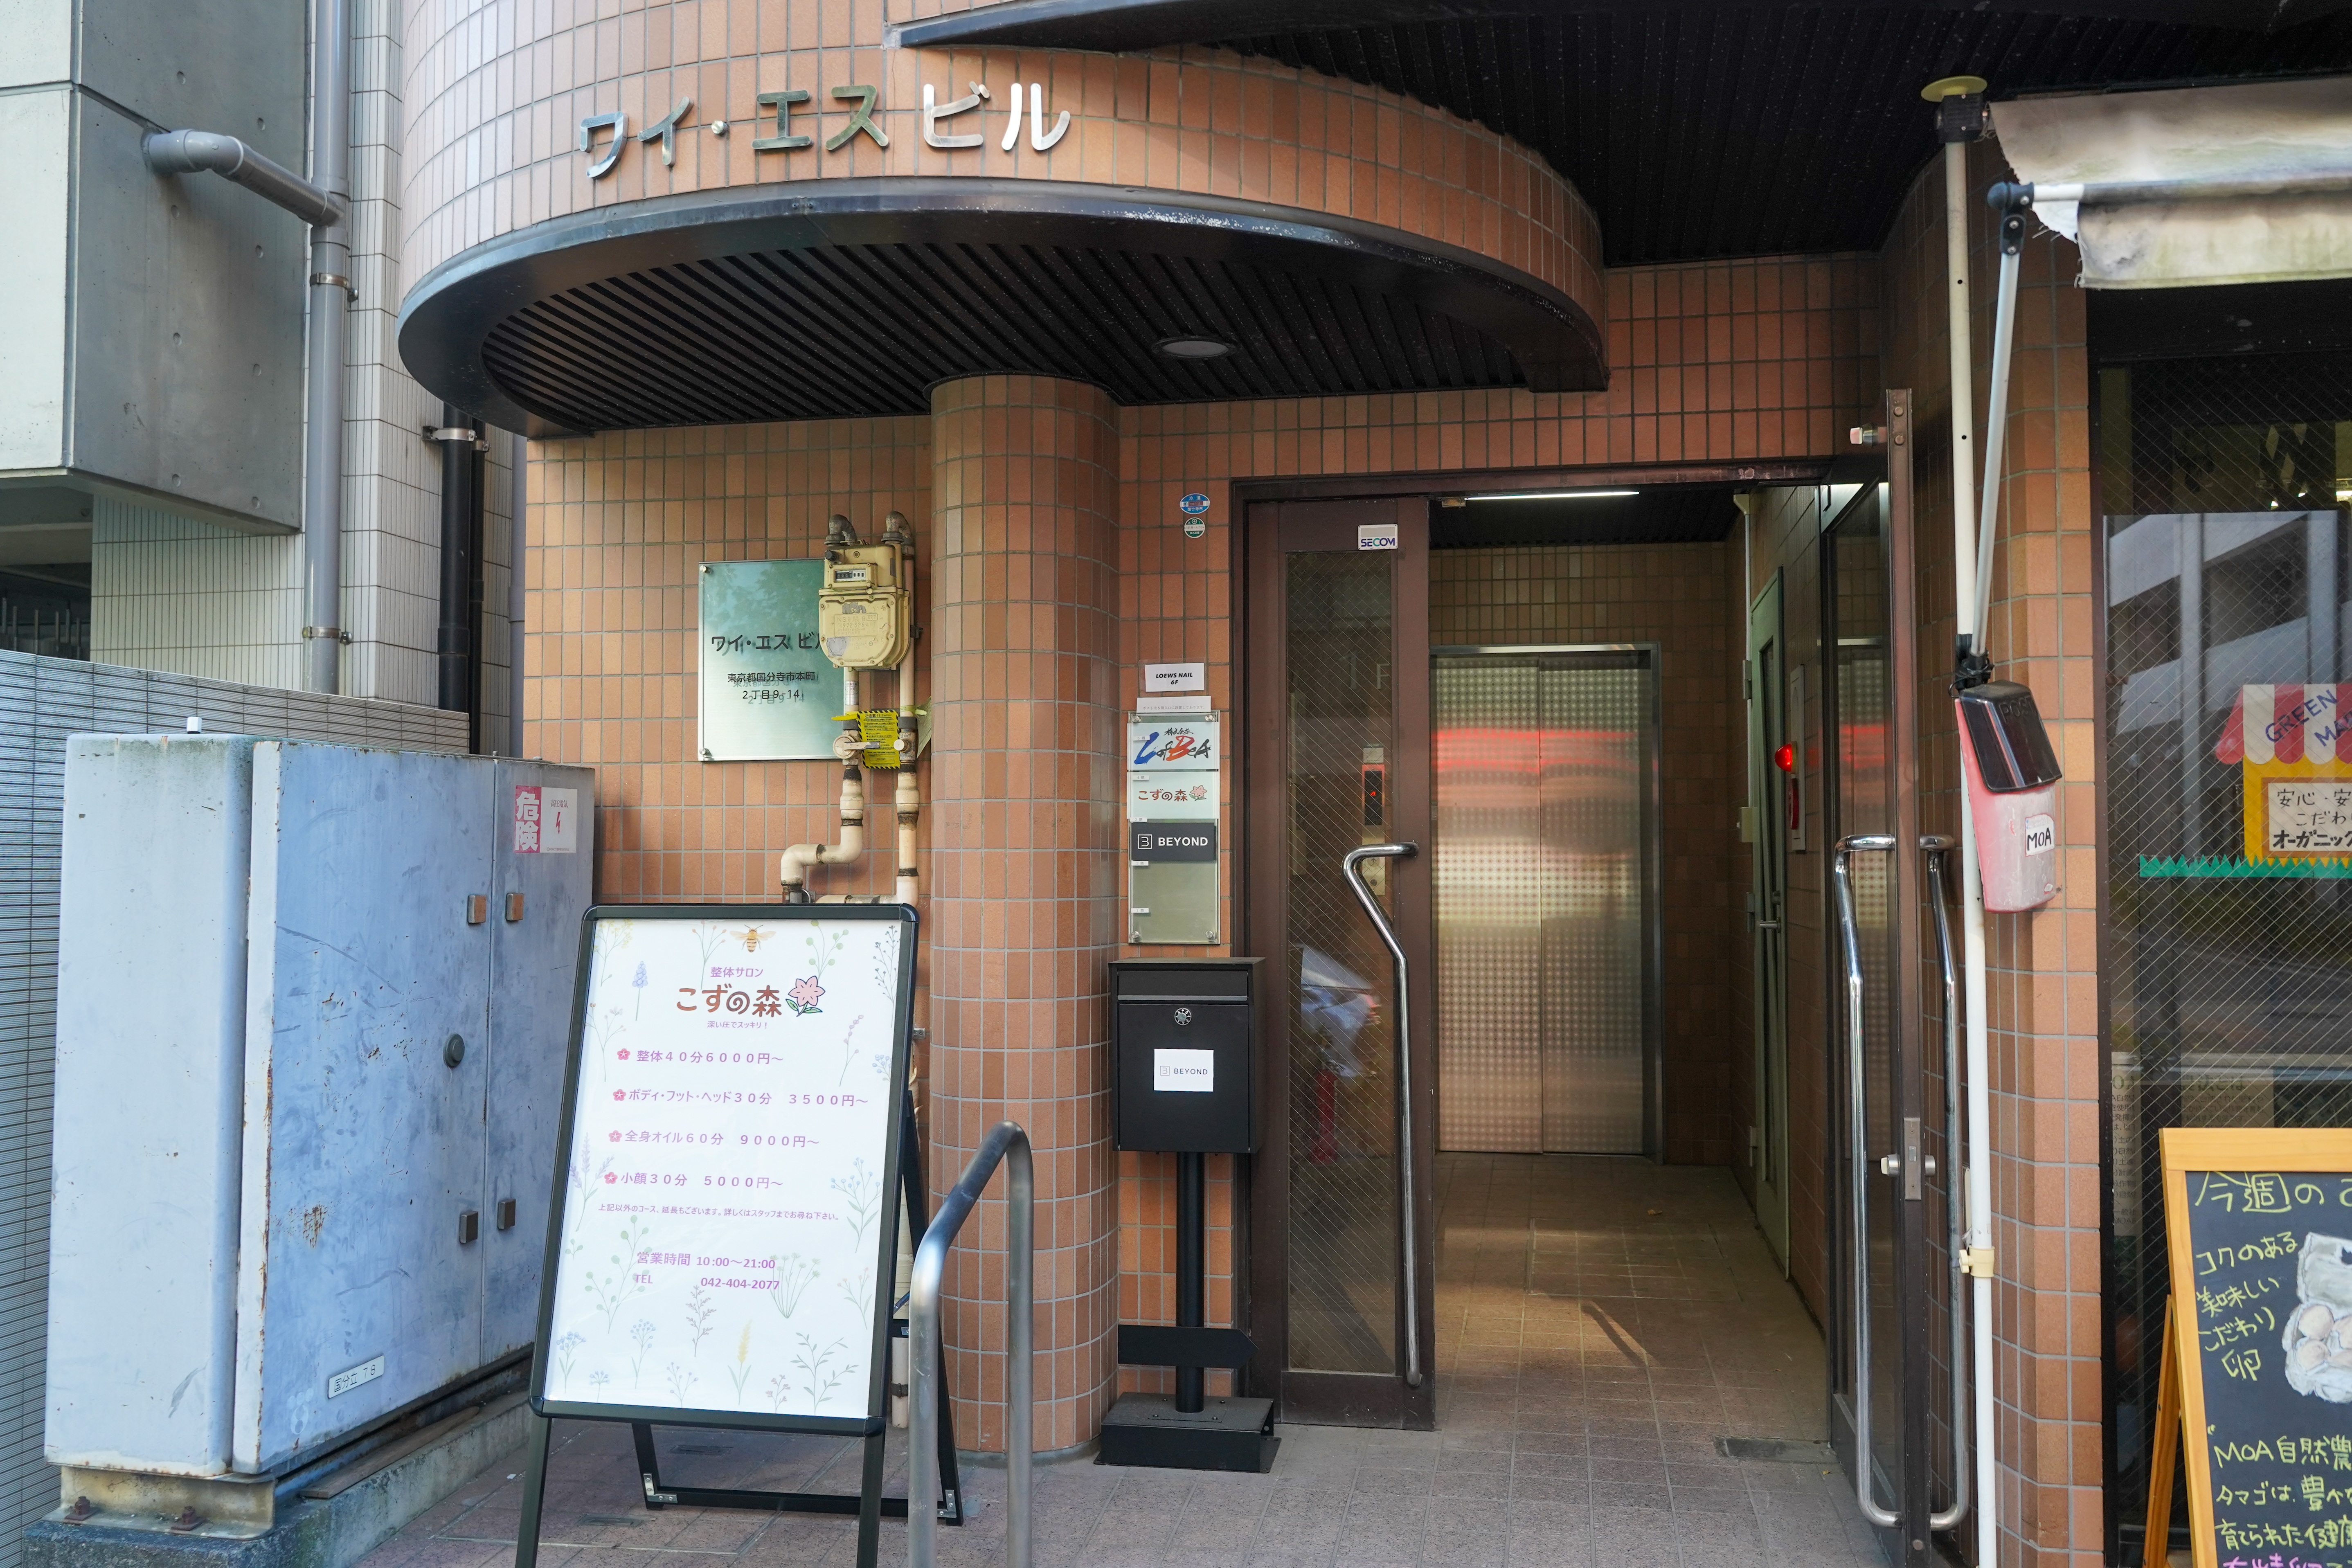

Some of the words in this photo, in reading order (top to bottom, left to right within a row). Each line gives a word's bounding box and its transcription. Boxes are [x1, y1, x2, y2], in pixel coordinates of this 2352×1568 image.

[579, 84, 890, 179] ワイ・エス
[923, 80, 1071, 151] ビル
[1361, 538, 1395, 547] SECOM
[712, 634, 789, 652] ワイ・エス
[727, 671, 815, 683] 東京都国分寺市本町
[743, 689, 800, 700] 2丁目9-14
[2265, 689, 2338, 743] GREEN
[551, 799, 568, 808] 高圧電気
[1139, 789, 1188, 802] こずの森
[515, 791, 540, 851] 危険
[2296, 811, 2352, 826] こだわ
[1158, 837, 1209, 846] BEYOND
[2027, 827, 2051, 851] MOA
[710, 966, 763, 978] 整体サロン
[676, 983, 782, 1018] こずの森
[625, 1129, 724, 1145] 全身オイル60分
[621, 1172, 688, 1187] 小顔30分
[637, 1251, 691, 1266] 営業時間
[2196, 1231, 2298, 1276] コクのある
[635, 1273, 653, 1285] TEL
[700, 1277, 780, 1290] 042-404-2077
[2196, 1277, 2280, 1318] 美味しい
[2199, 1306, 2275, 1351] こだわり
[2221, 1349, 2261, 1381] 卵
[334, 1372, 358, 1393] 国分立
[363, 1364, 376, 1378] 78
